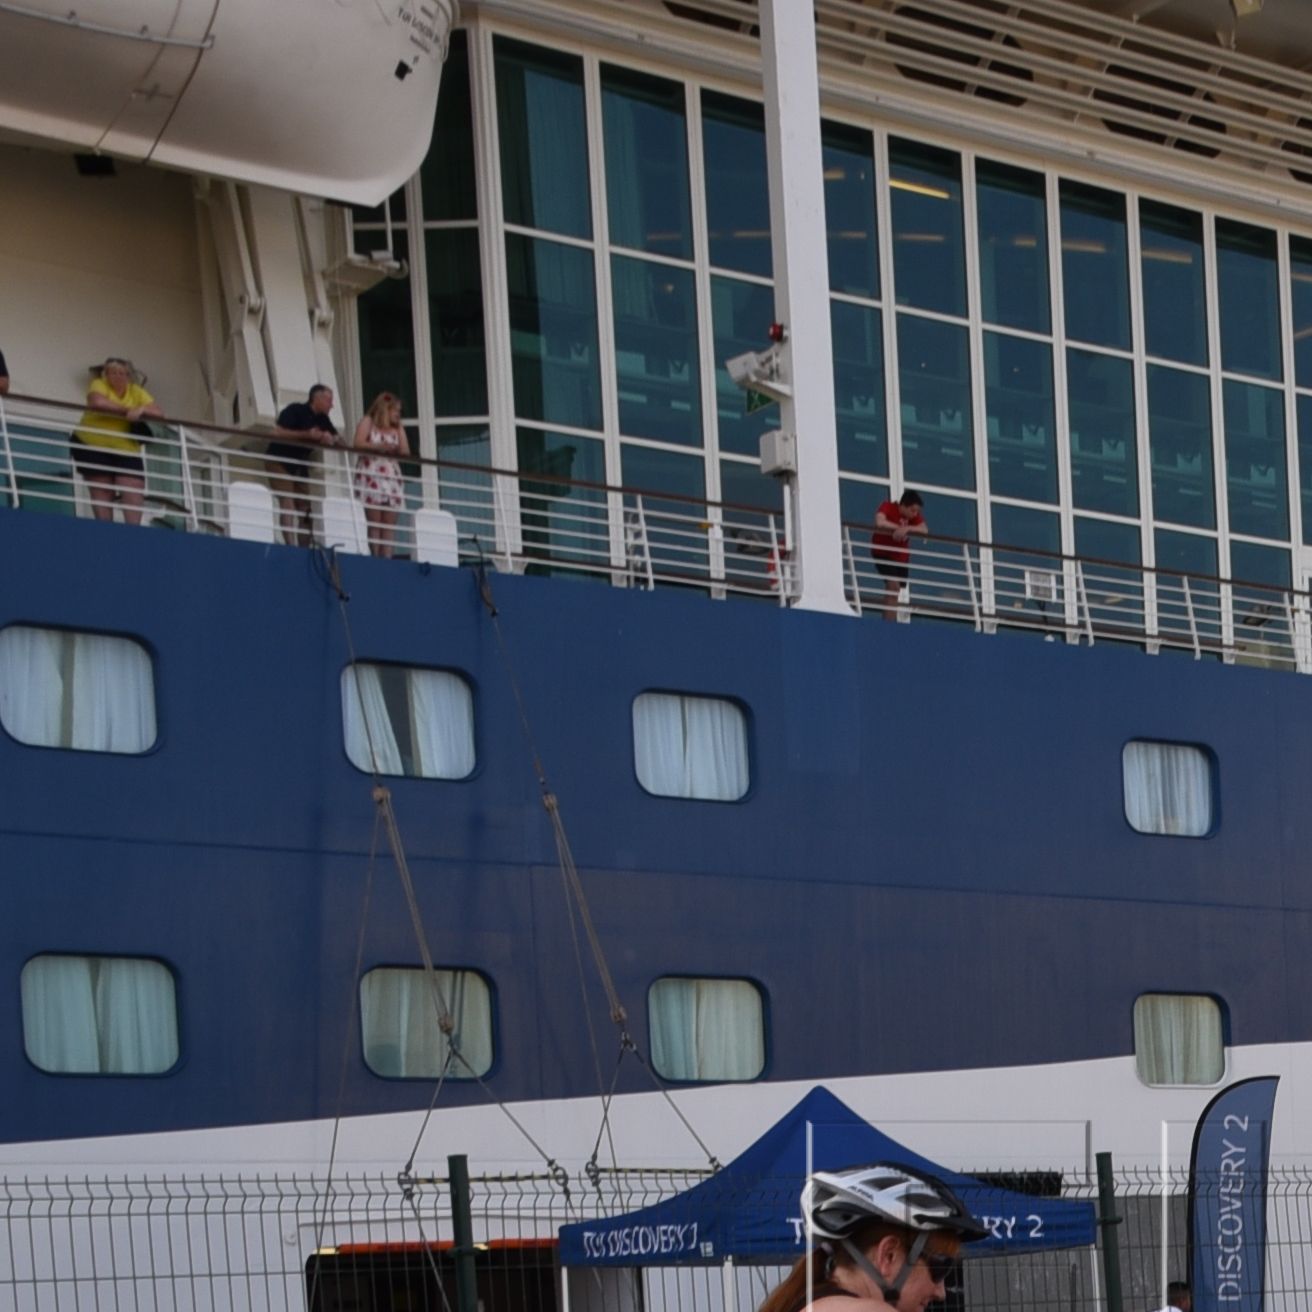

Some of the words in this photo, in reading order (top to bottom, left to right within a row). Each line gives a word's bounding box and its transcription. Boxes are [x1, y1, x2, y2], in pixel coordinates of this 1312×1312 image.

[1224, 1114, 1249, 1131] 2
[1026, 1214, 1044, 1238] 2
[1217, 1138, 1248, 1301] DISCOVERY
[583, 1232, 606, 1258] TUI
[608, 1224, 688, 1256] DISCOVERY
